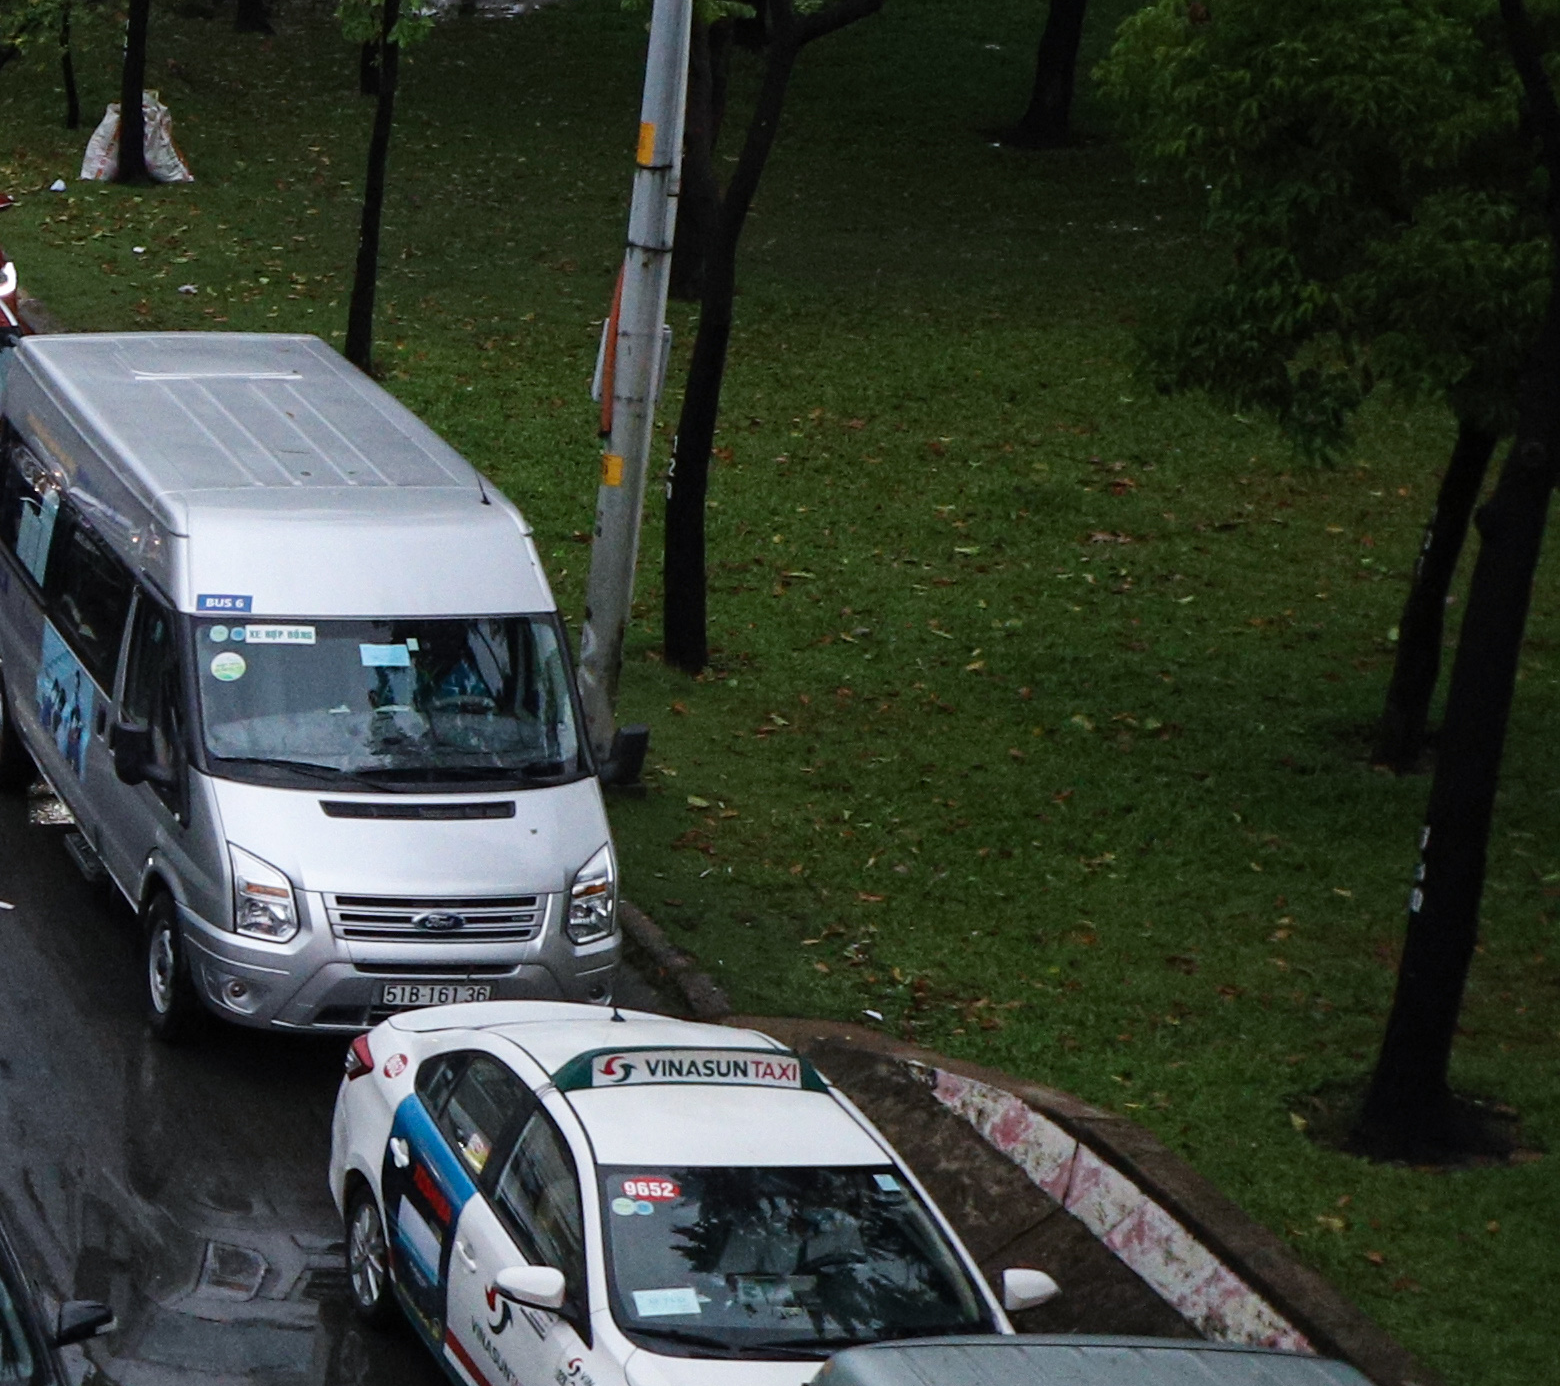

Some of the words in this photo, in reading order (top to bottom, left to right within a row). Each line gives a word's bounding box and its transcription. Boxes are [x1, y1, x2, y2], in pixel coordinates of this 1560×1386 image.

[206, 598, 232, 608] BUS
[235, 598, 244, 609] 6
[624, 1182, 675, 1197] 9652
